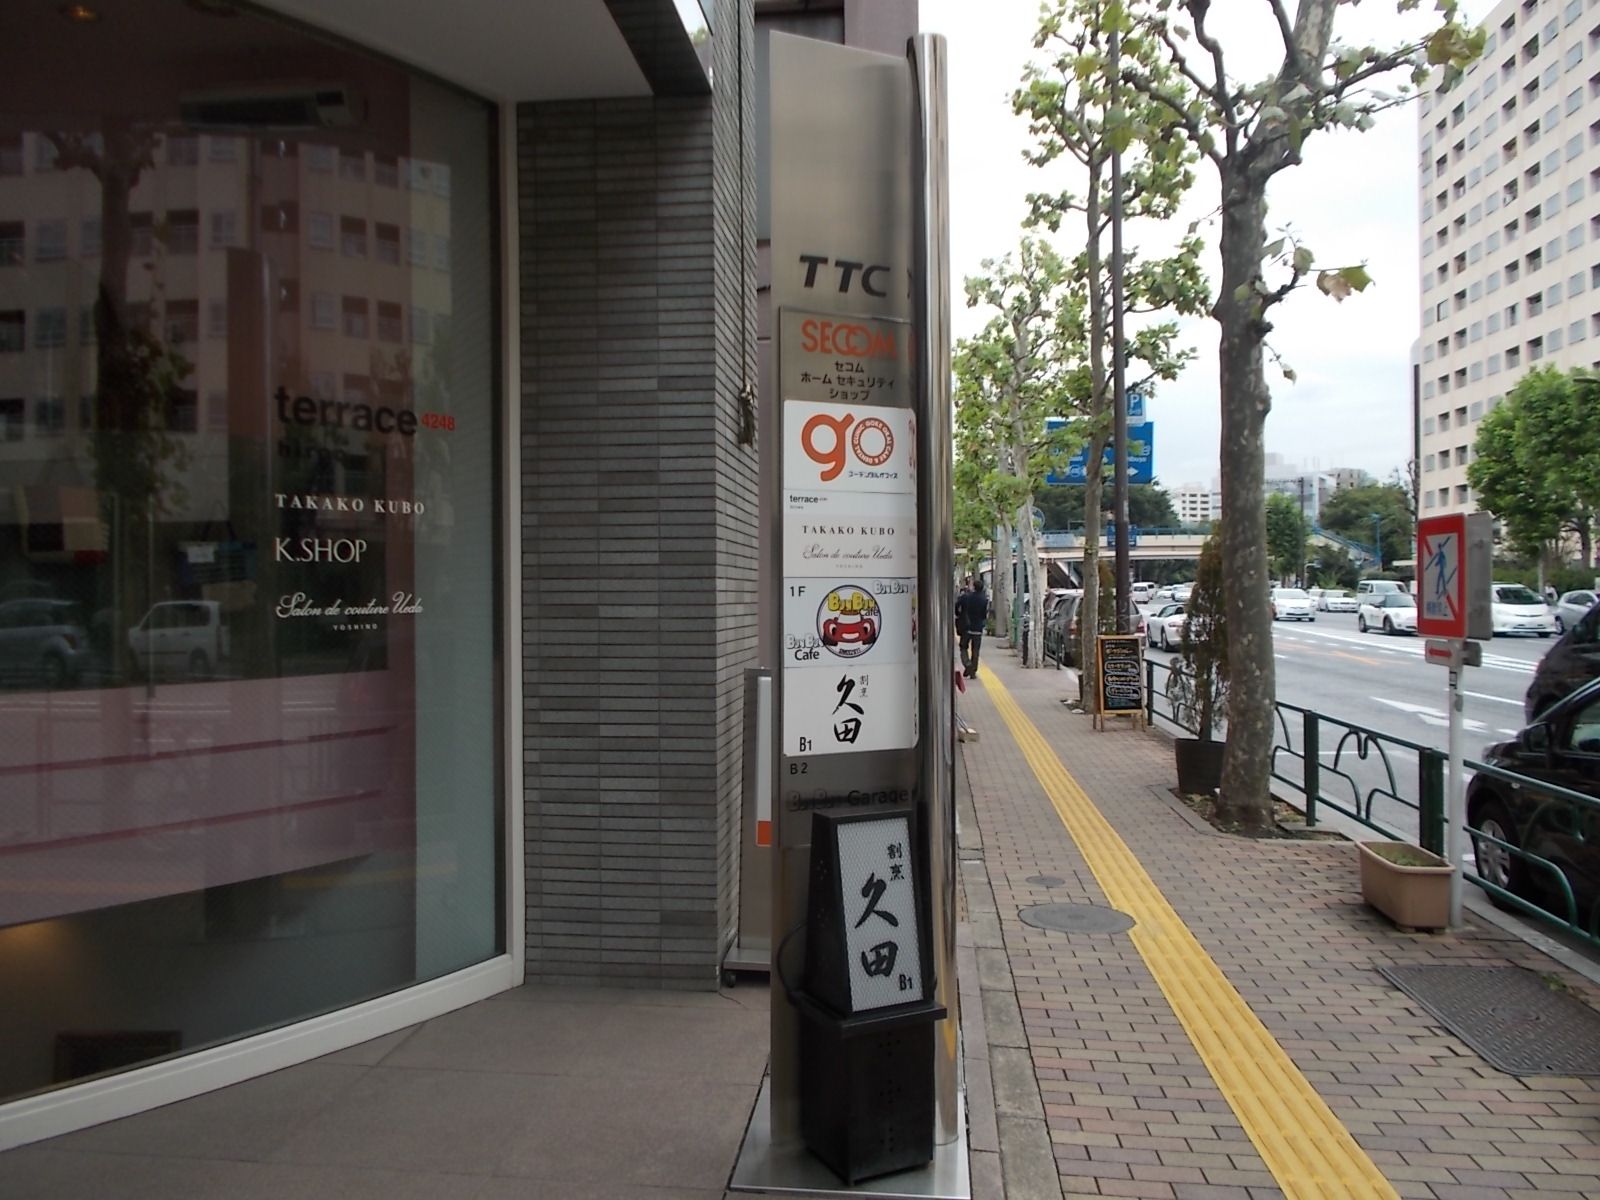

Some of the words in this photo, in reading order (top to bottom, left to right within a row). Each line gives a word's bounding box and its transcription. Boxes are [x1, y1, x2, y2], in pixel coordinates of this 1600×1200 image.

[800, 254, 891, 298] TTC
[801, 319, 897, 360] SECOM
[835, 360, 864, 373] セコム
[801, 371, 832, 384] ホーム
[836, 374, 895, 389] セキュリティ
[829, 388, 870, 400] ショップ
[275, 386, 418, 435] terrace
[420, 411, 457, 431] 4248
[801, 413, 895, 482] go
[274, 493, 364, 512] TAKAKO
[374, 499, 425, 515] KUBO
[789, 494, 818, 503] terrace
[802, 525, 854, 535] TAKAKO
[861, 526, 895, 536] KUBO
[275, 537, 367, 563] K.SHOP
[275, 591, 322, 619] Salon
[324, 599, 342, 616] de
[344, 598, 389, 615] couture
[794, 646, 820, 661] Cafe
[831, 673, 865, 744] 久田
[799, 736, 812, 752] B1
[854, 871, 899, 977] 久田
[899, 973, 913, 991] B1
